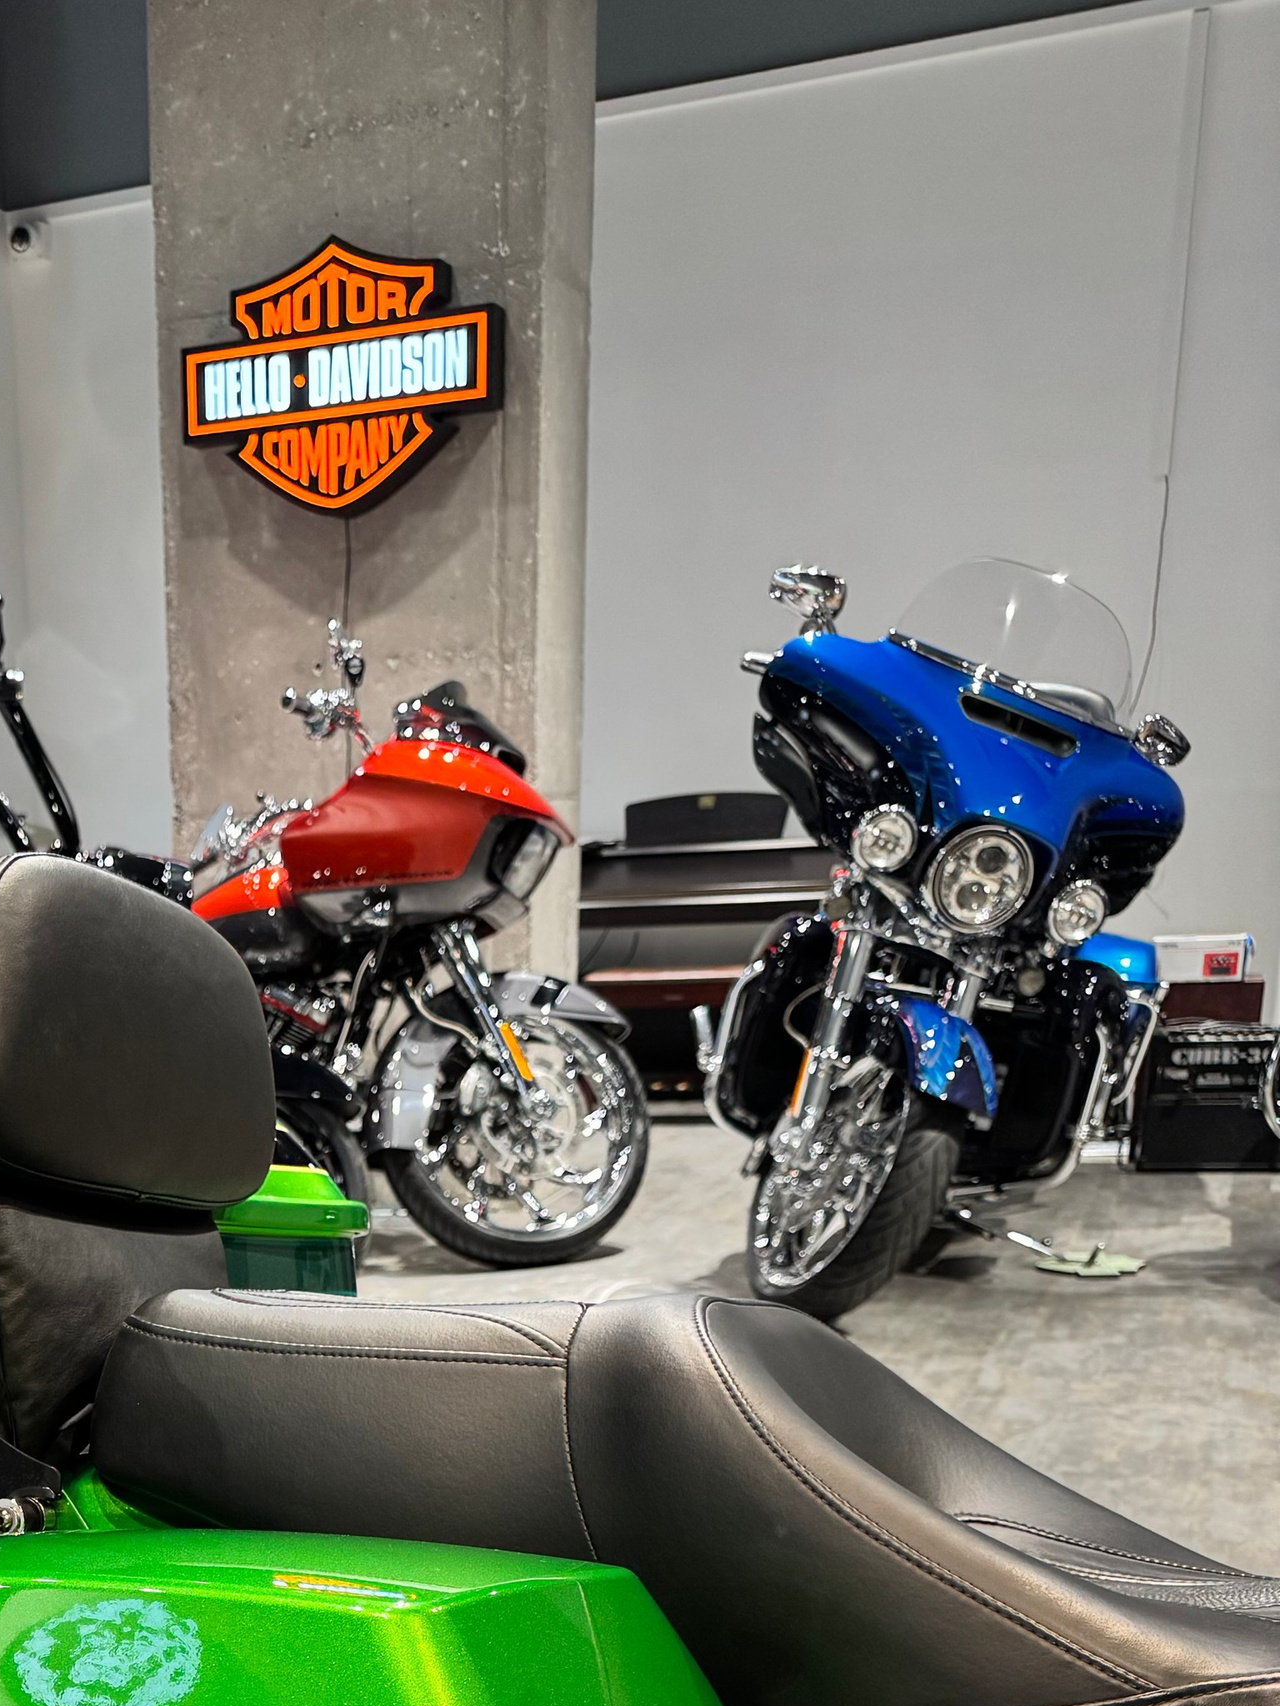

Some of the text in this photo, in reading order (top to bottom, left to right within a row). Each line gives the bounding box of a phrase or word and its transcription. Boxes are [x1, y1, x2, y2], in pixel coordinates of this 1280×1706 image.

[262, 263, 407, 337] MOTOR
[204, 327, 468, 421] HELLO DAVIDSON
[262, 415, 408, 495] COMPANY
